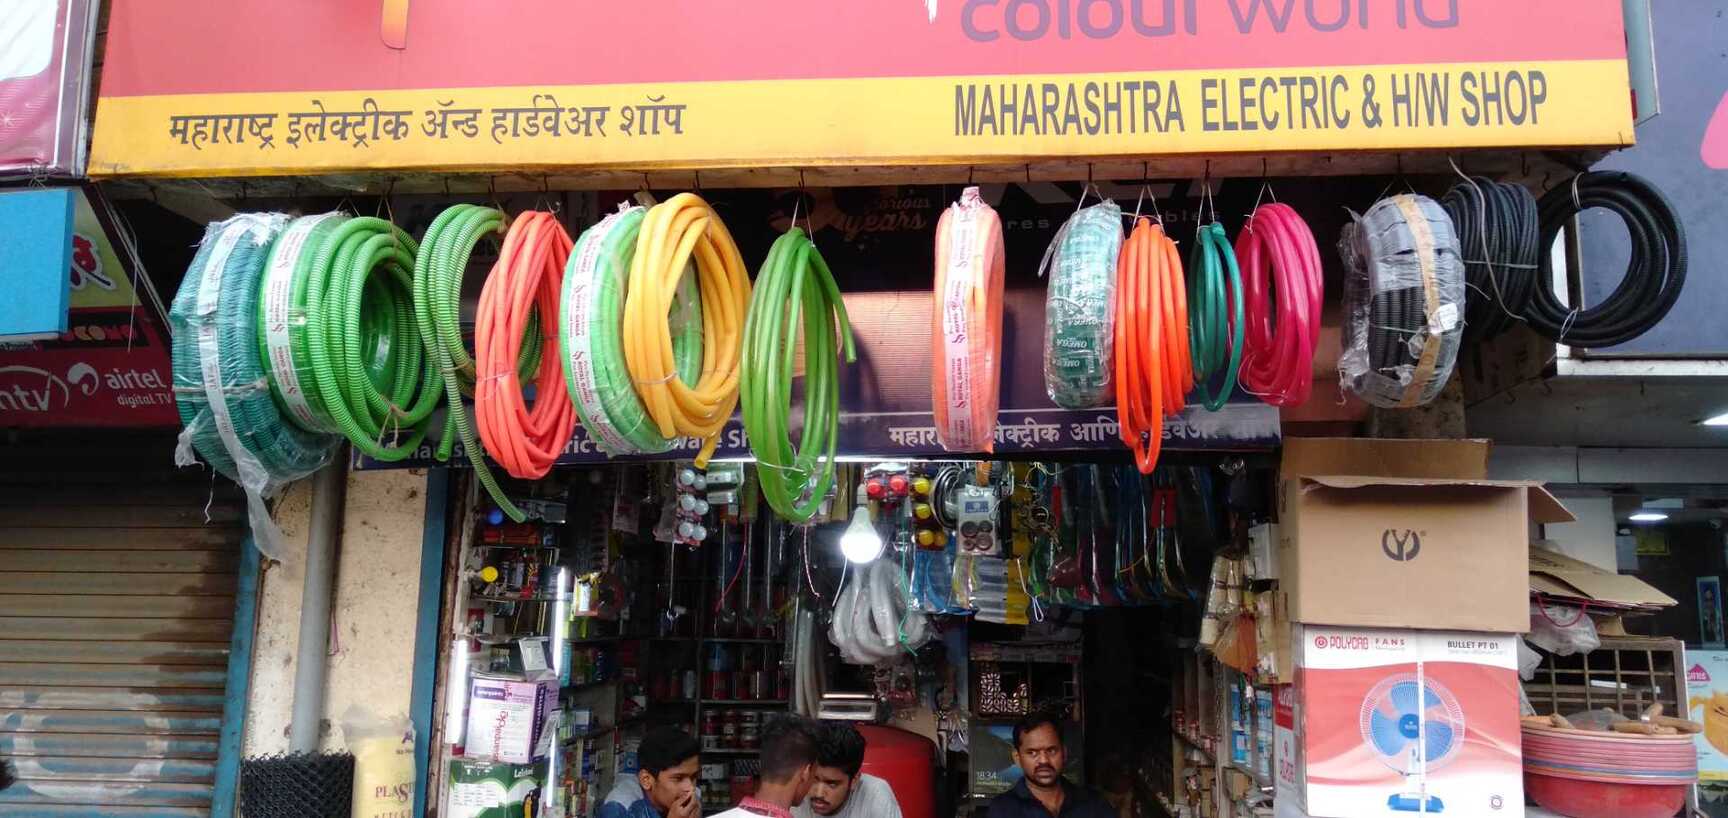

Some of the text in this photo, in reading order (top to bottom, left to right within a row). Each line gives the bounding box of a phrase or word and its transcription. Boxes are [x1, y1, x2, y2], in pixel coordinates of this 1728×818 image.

[954, 69, 1548, 137] MAHARASHTRA ELECTRIC & H/W SHOP
[169, 113, 277, 149] महाराष्ट्र
[286, 98, 413, 149] इलेक्ट्रीक
[490, 94, 610, 141] हार्डवेअर
[619, 94, 687, 137] शॉप
[1056, 338, 1088, 349] OMEGA
[104, 368, 167, 389] airtel
[117, 393, 172, 408] digital TV
[1447, 640, 1475, 649] BULLET
[1477, 641, 1488, 649] PT
